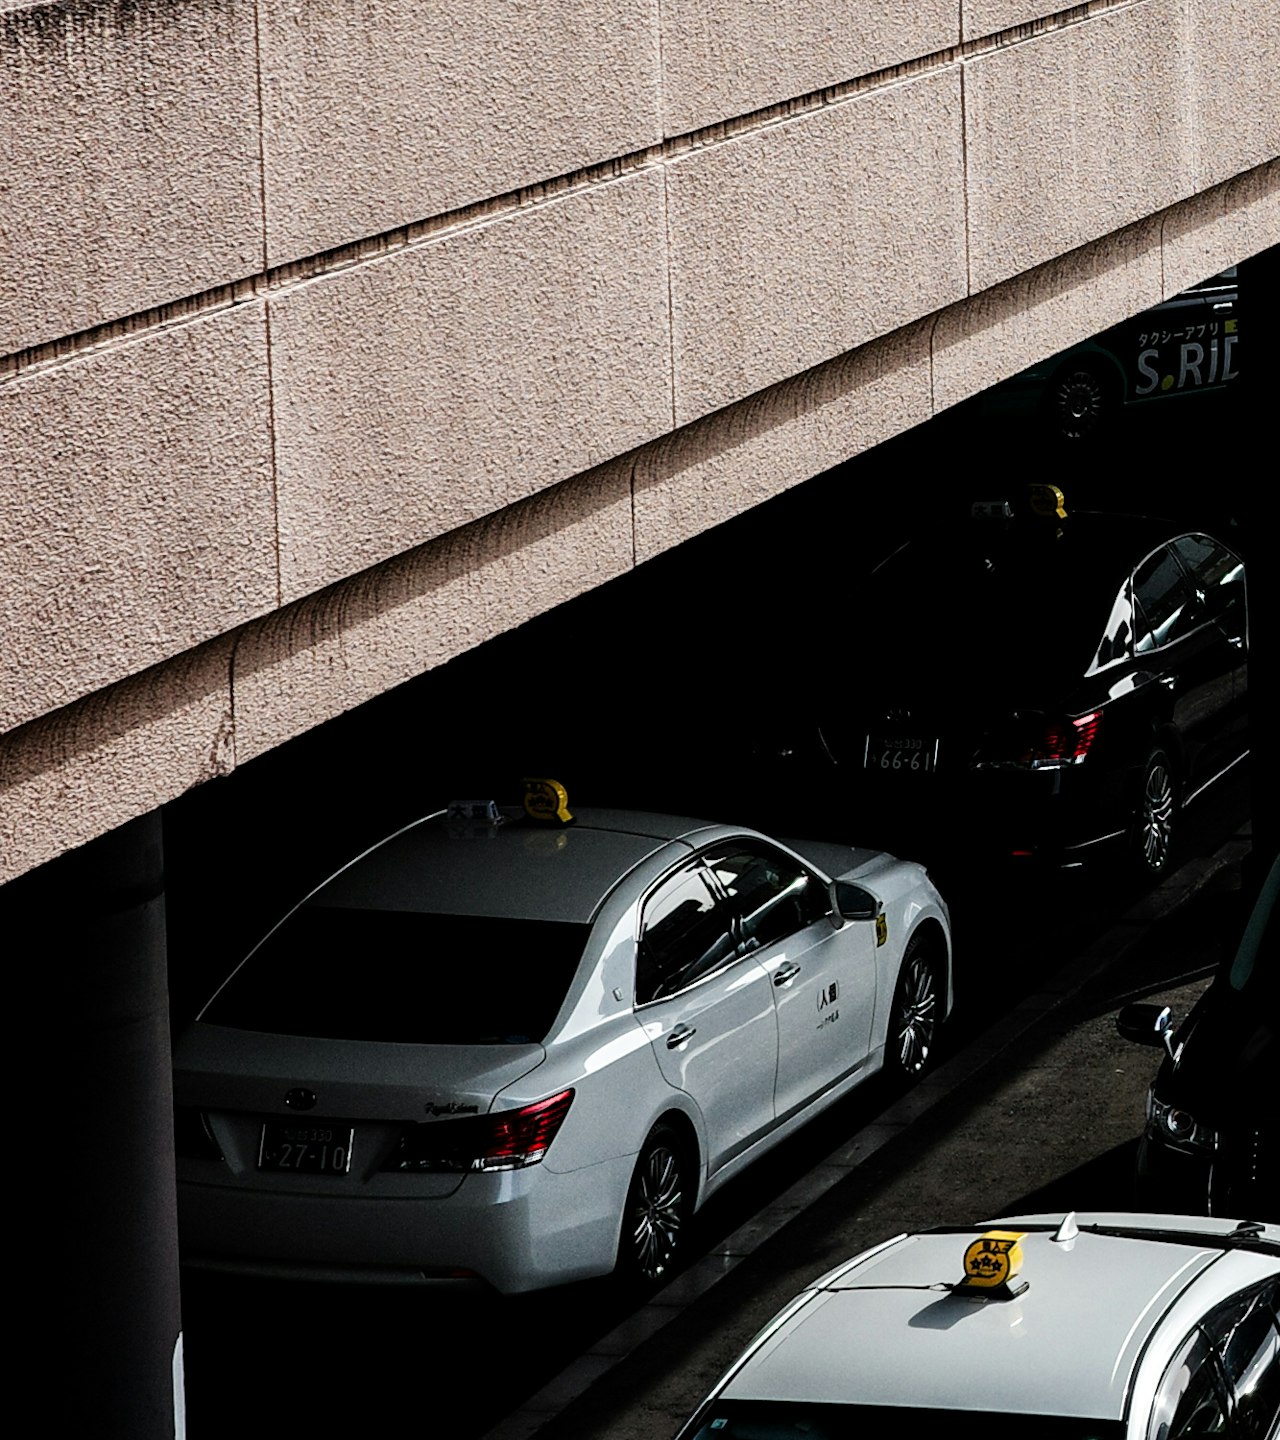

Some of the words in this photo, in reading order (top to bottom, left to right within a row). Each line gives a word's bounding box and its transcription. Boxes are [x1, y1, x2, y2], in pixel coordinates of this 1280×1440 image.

[1138, 322, 1220, 345] タクシーアプリ
[881, 750, 930, 772] 66-61
[279, 1144, 346, 1171] 27-10
